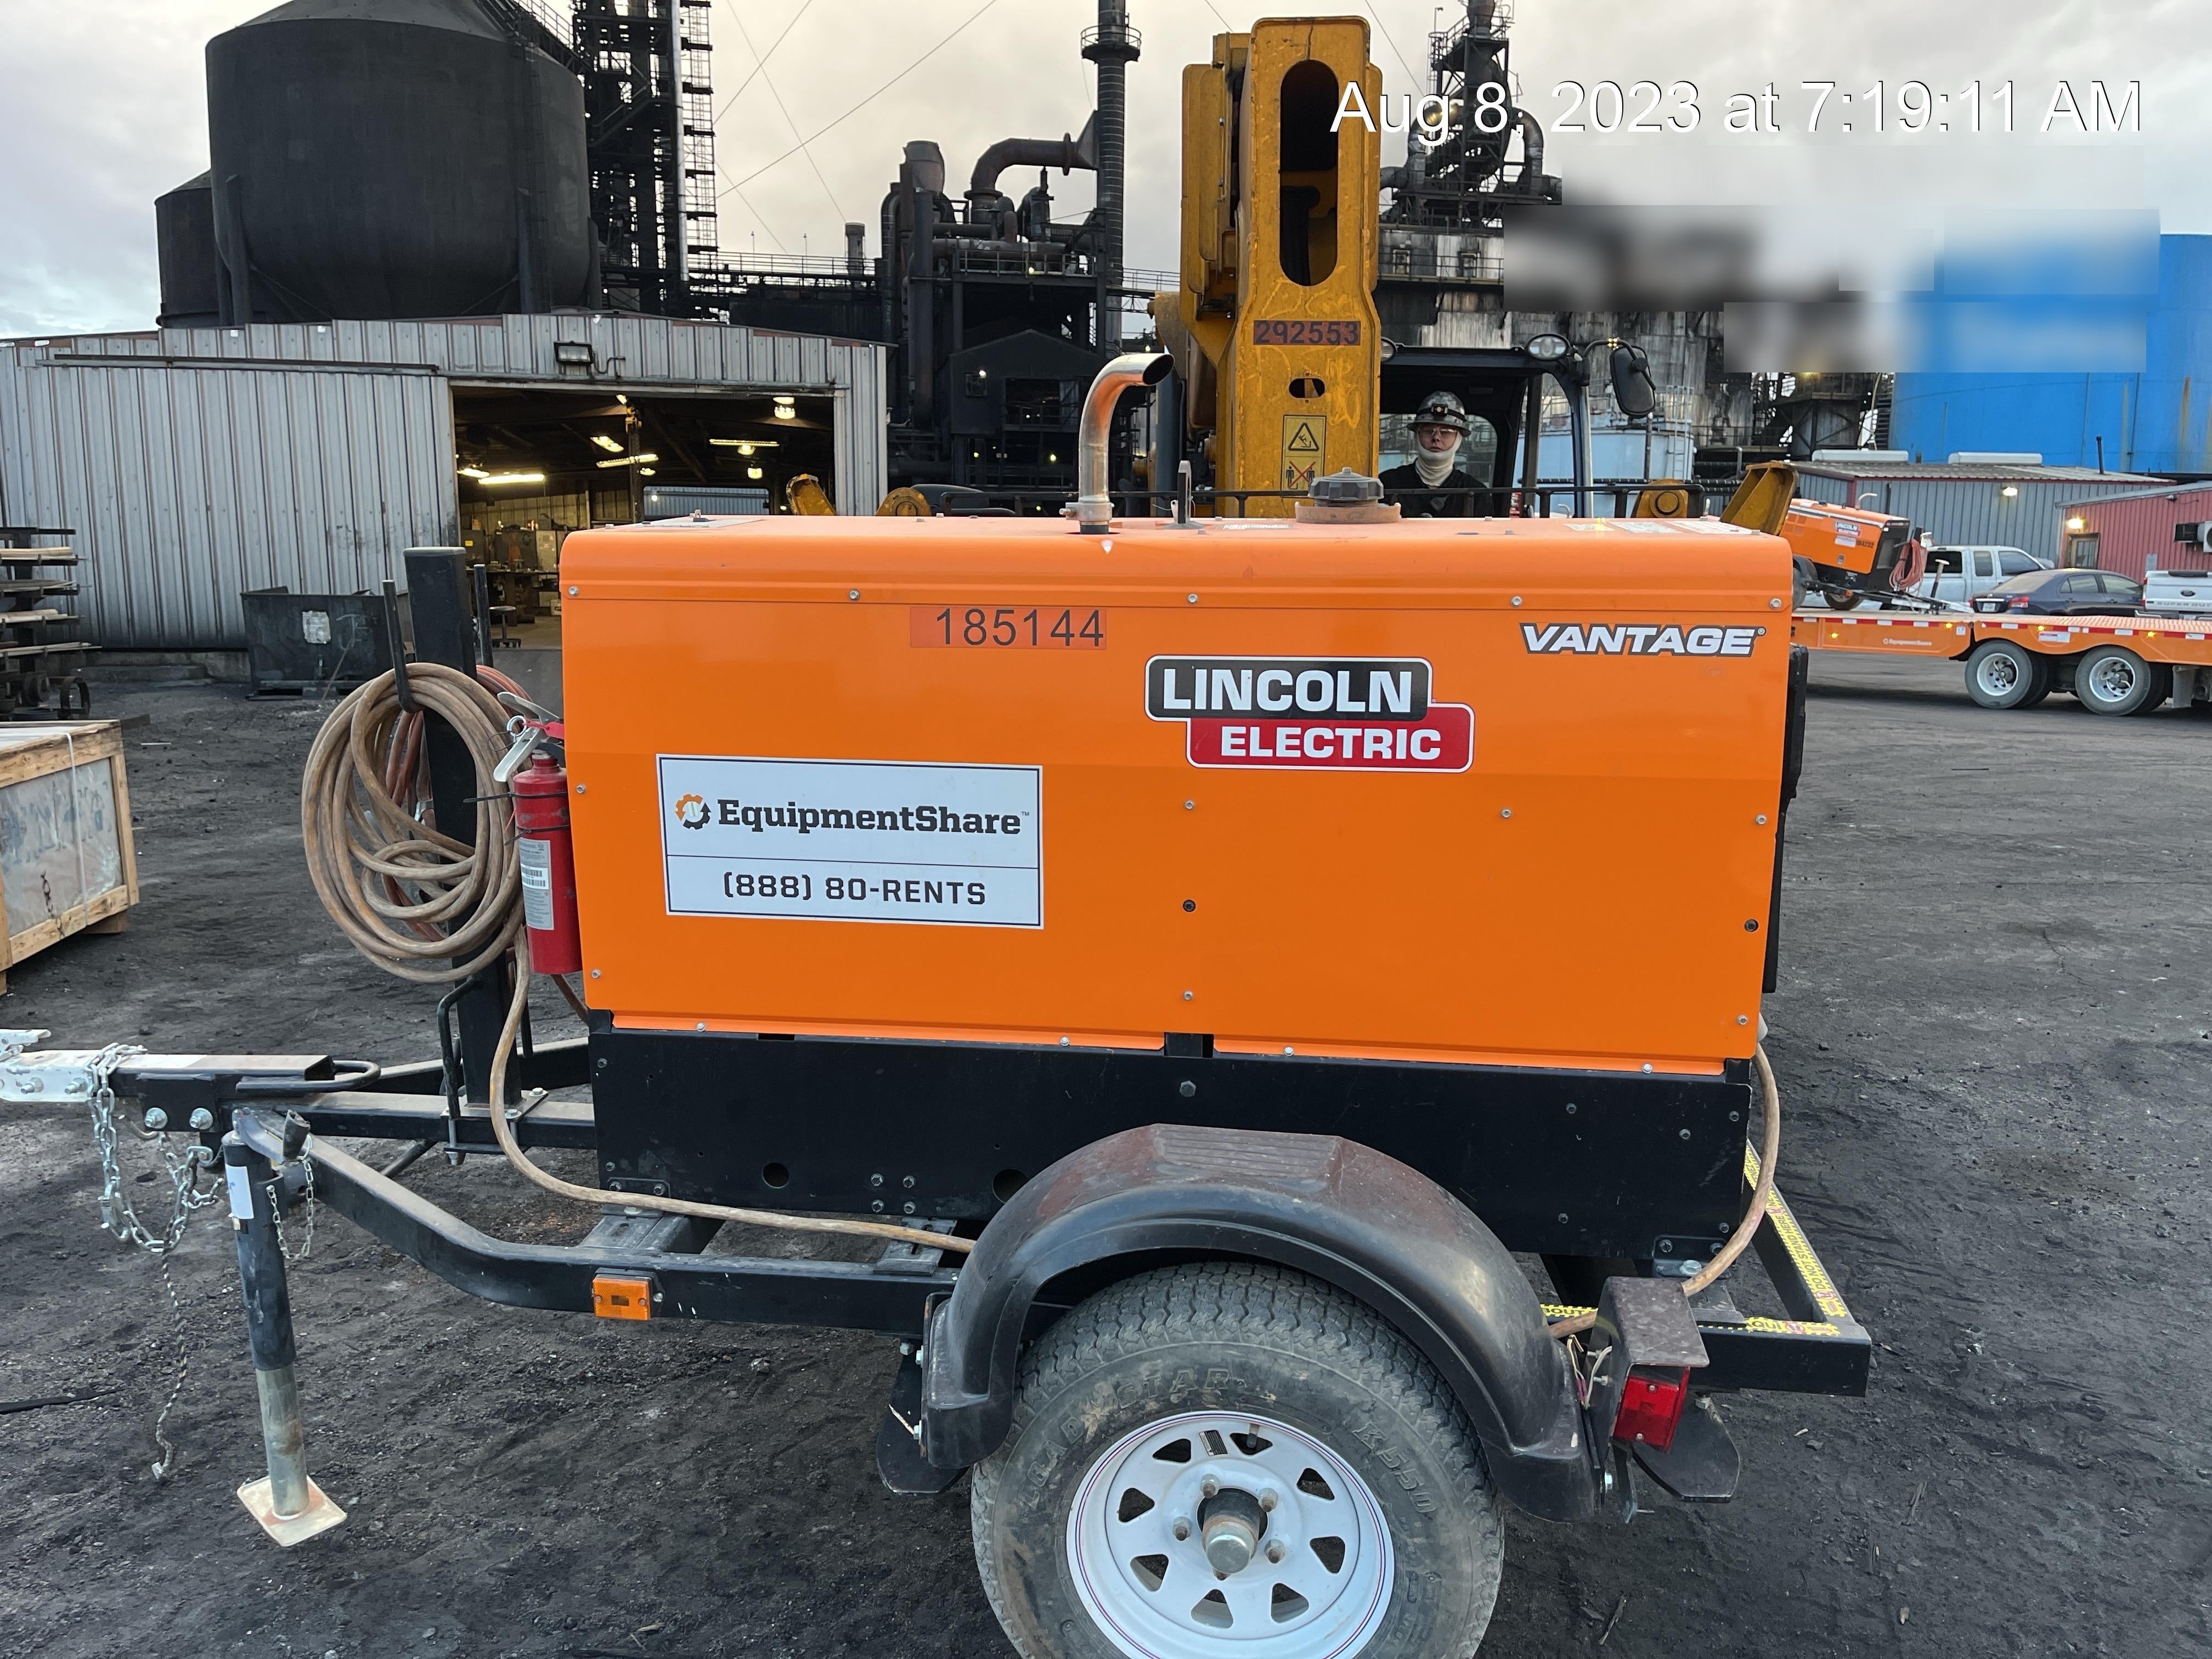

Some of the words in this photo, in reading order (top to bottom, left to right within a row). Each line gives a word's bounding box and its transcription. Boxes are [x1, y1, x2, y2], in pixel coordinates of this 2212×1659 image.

[1255, 320, 1359, 345] 292553
[936, 608, 1104, 647] 185144
[1522, 625, 1756, 654] VANTAGE
[1163, 668, 1412, 713] LINCOLN
[1221, 725, 1441, 760] ELECTRIC
[717, 799, 1021, 834] EquipmentShare
[724, 871, 811, 900] (888)
[825, 877, 986, 905] 80-RENTS
[1775, 1215, 1793, 1233] HERE
[1787, 1235, 1809, 1260] STAND
[1801, 1260, 1819, 1277] NOT
[1812, 1278, 1826, 1289] DO
